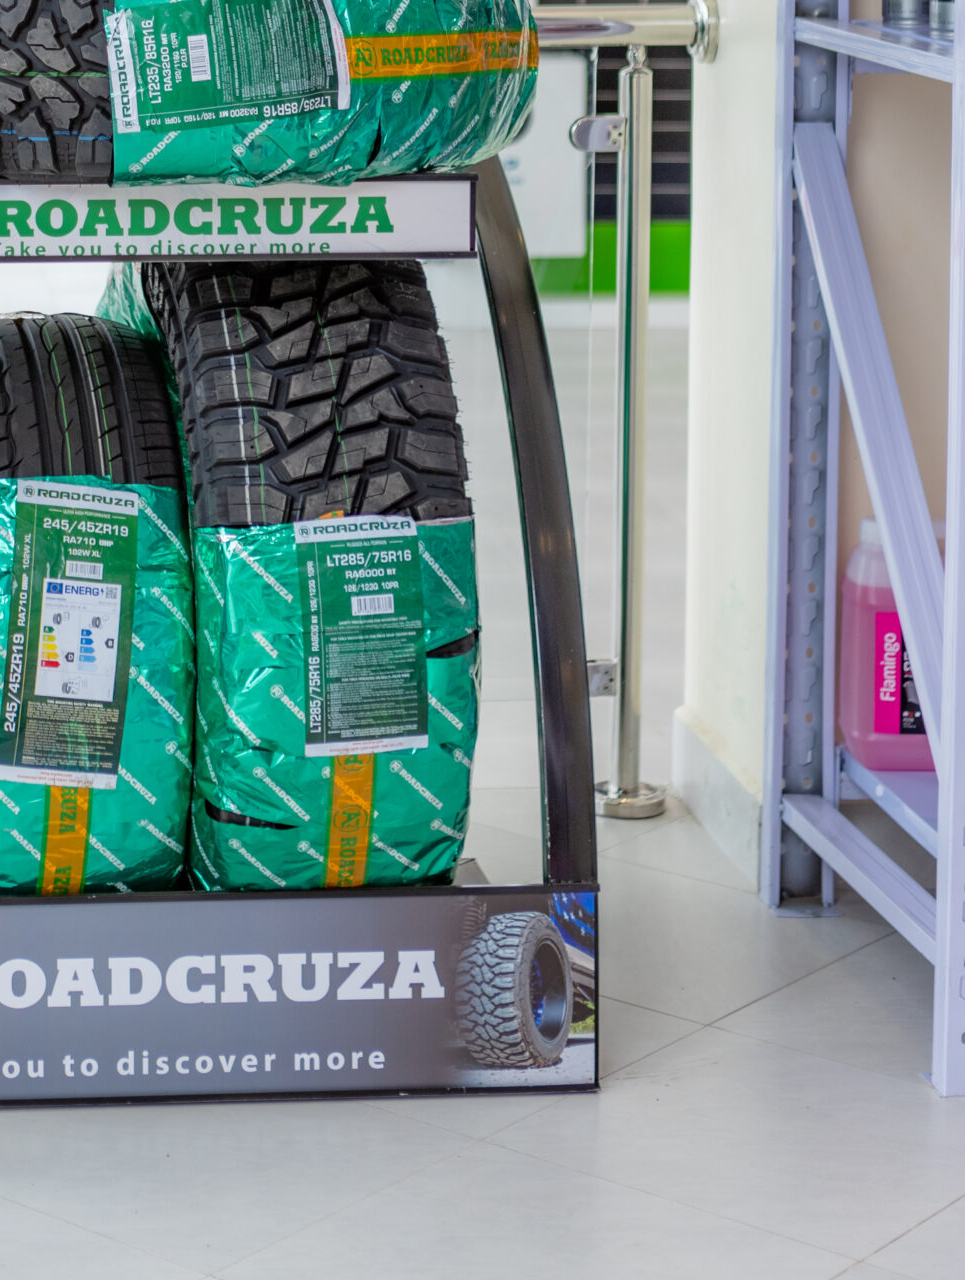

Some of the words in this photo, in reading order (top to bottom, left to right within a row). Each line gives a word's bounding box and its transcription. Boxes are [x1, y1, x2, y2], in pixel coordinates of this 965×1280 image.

[170, 32, 179, 49] 10PR
[141, 19, 162, 104] LT235/85R16
[381, 44, 469, 65] ROADCRUZA
[160, 47, 173, 91] RA3200
[230, 107, 258, 118] RA3200
[263, 96, 332, 118] LT235/85R16
[115, 243, 138, 256] to
[150, 239, 256, 255] discover
[268, 243, 331, 254] more
[37, 488, 135, 508] ROADCRUZA
[43, 517, 129, 537] 245/45ZR19
[313, 520, 412, 535] ROADCRUZA
[63, 535, 96, 546] RA710
[68, 548, 91, 558] 102W
[91, 550, 101, 558] XL
[326, 550, 412, 567] LT285/75R16
[239, 550, 294, 604] ROADCRUZA
[381, 581, 399, 590] 10PR
[64, 585, 99, 597] ENERG
[4, 633, 25, 733] 245/45ZR19
[17, 592, 27, 627] RA710
[23, 544, 31, 569] 102W
[880, 632, 901, 702] Flamingo
[136, 675, 185, 725] ROADCRUZA
[308, 656, 324, 734] LT285/75R16
[261, 776, 311, 822] ROADCRUZA
[399, 769, 444, 811] ROADCRUZA
[237, 846, 287, 888] ROADCRUZA
[62, 1055, 99, 1078] to
[117, 1050, 276, 1076] discover
[294, 1051, 385, 1071] more
